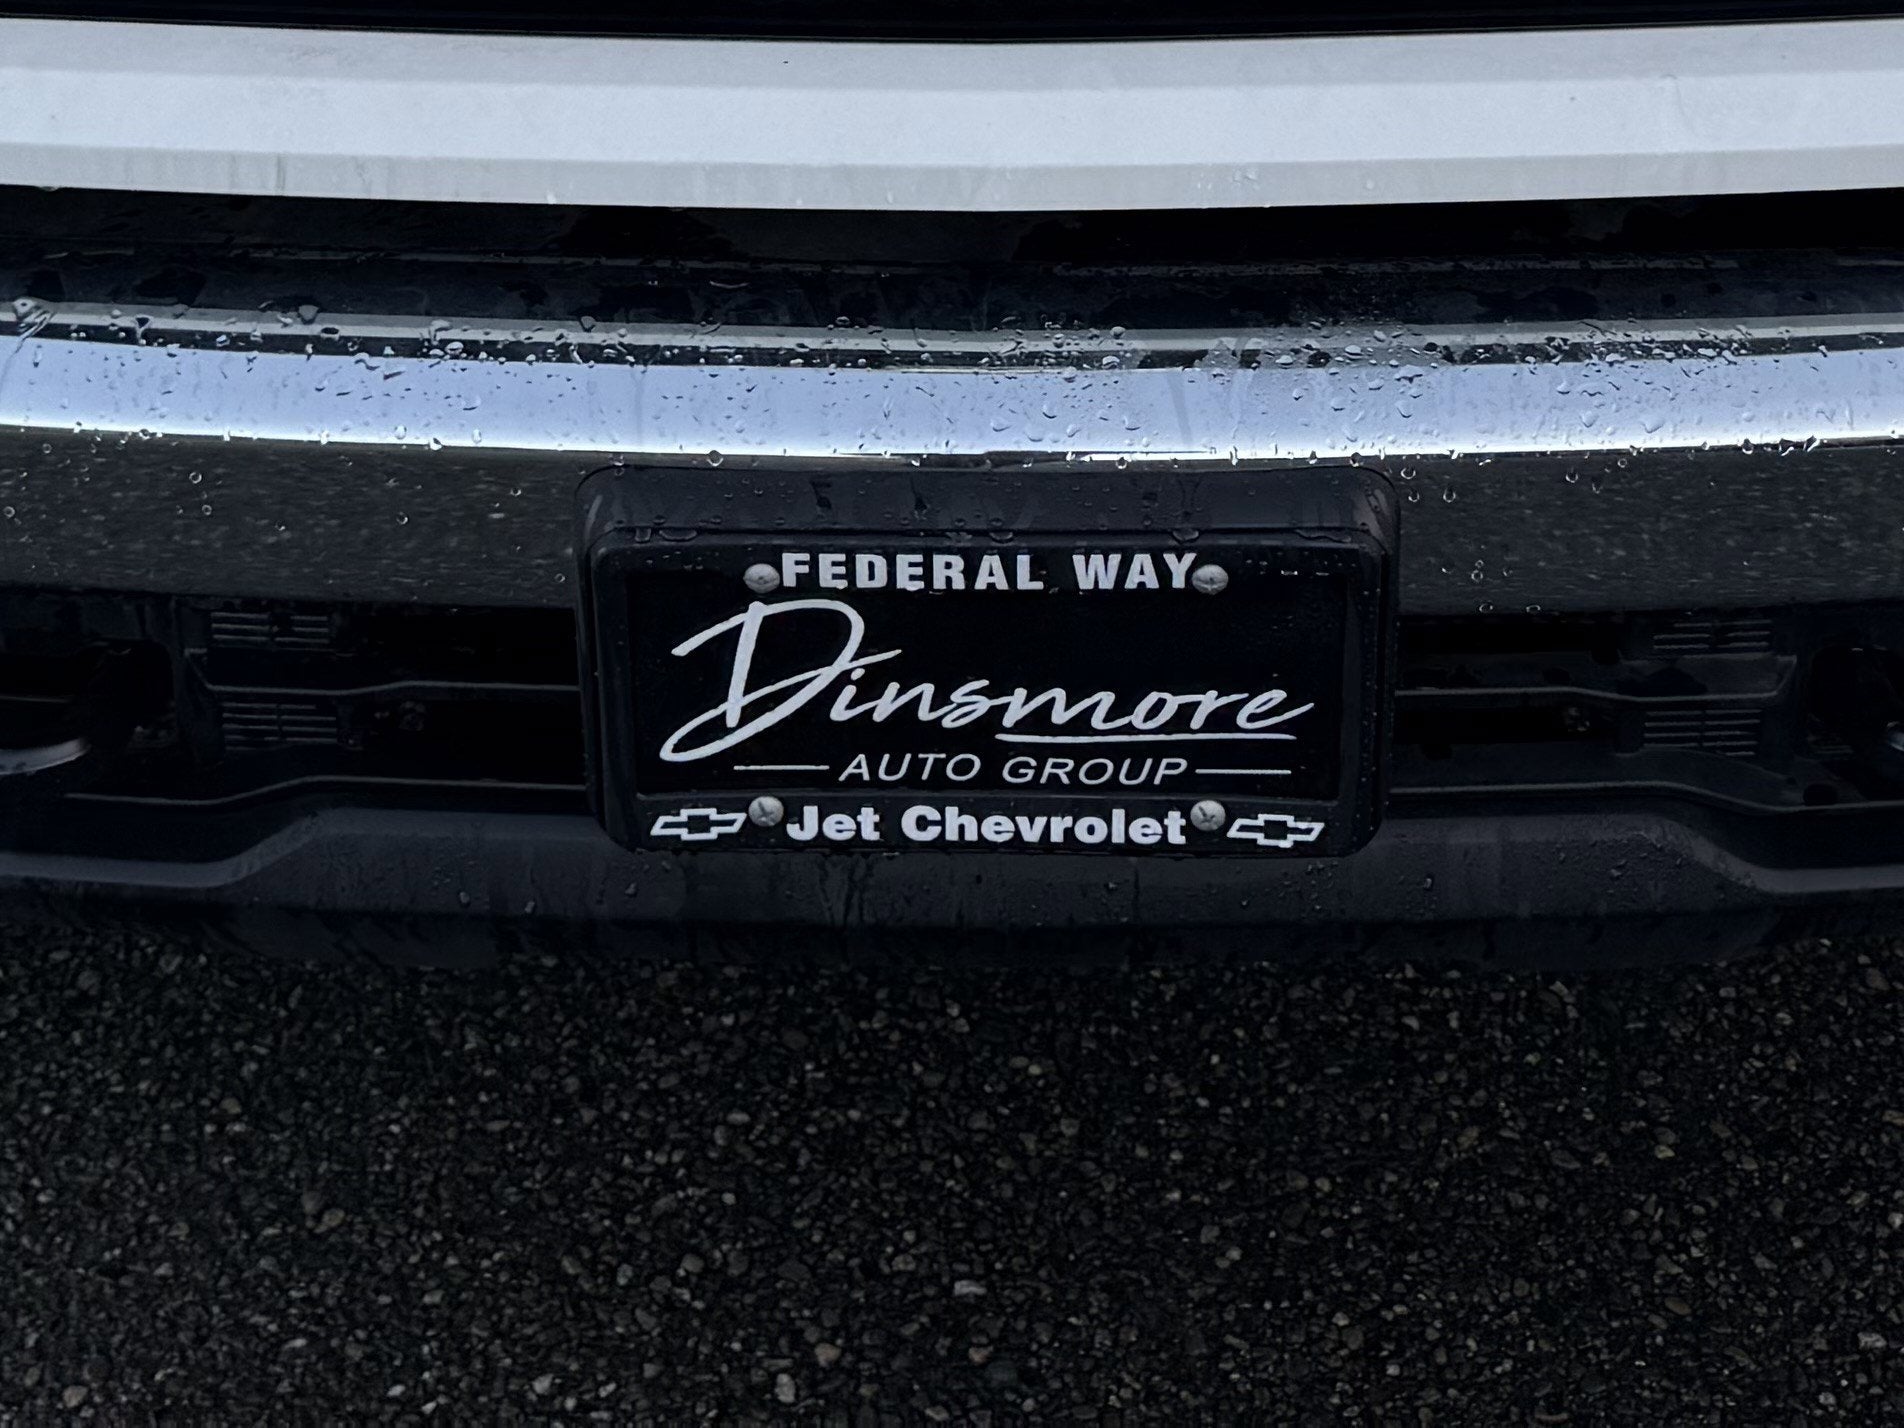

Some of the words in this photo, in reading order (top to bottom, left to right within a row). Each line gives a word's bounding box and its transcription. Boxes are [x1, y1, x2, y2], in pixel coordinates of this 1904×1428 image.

[781, 552, 1045, 592] FEDERAL
[1072, 552, 1198, 590] WAY
[659, 598, 1315, 763] Dinsmore
[838, 752, 982, 782] AUTO
[1002, 755, 1189, 786] GROUP
[785, 804, 881, 842] Jet
[900, 804, 1188, 846] Chevrolet
